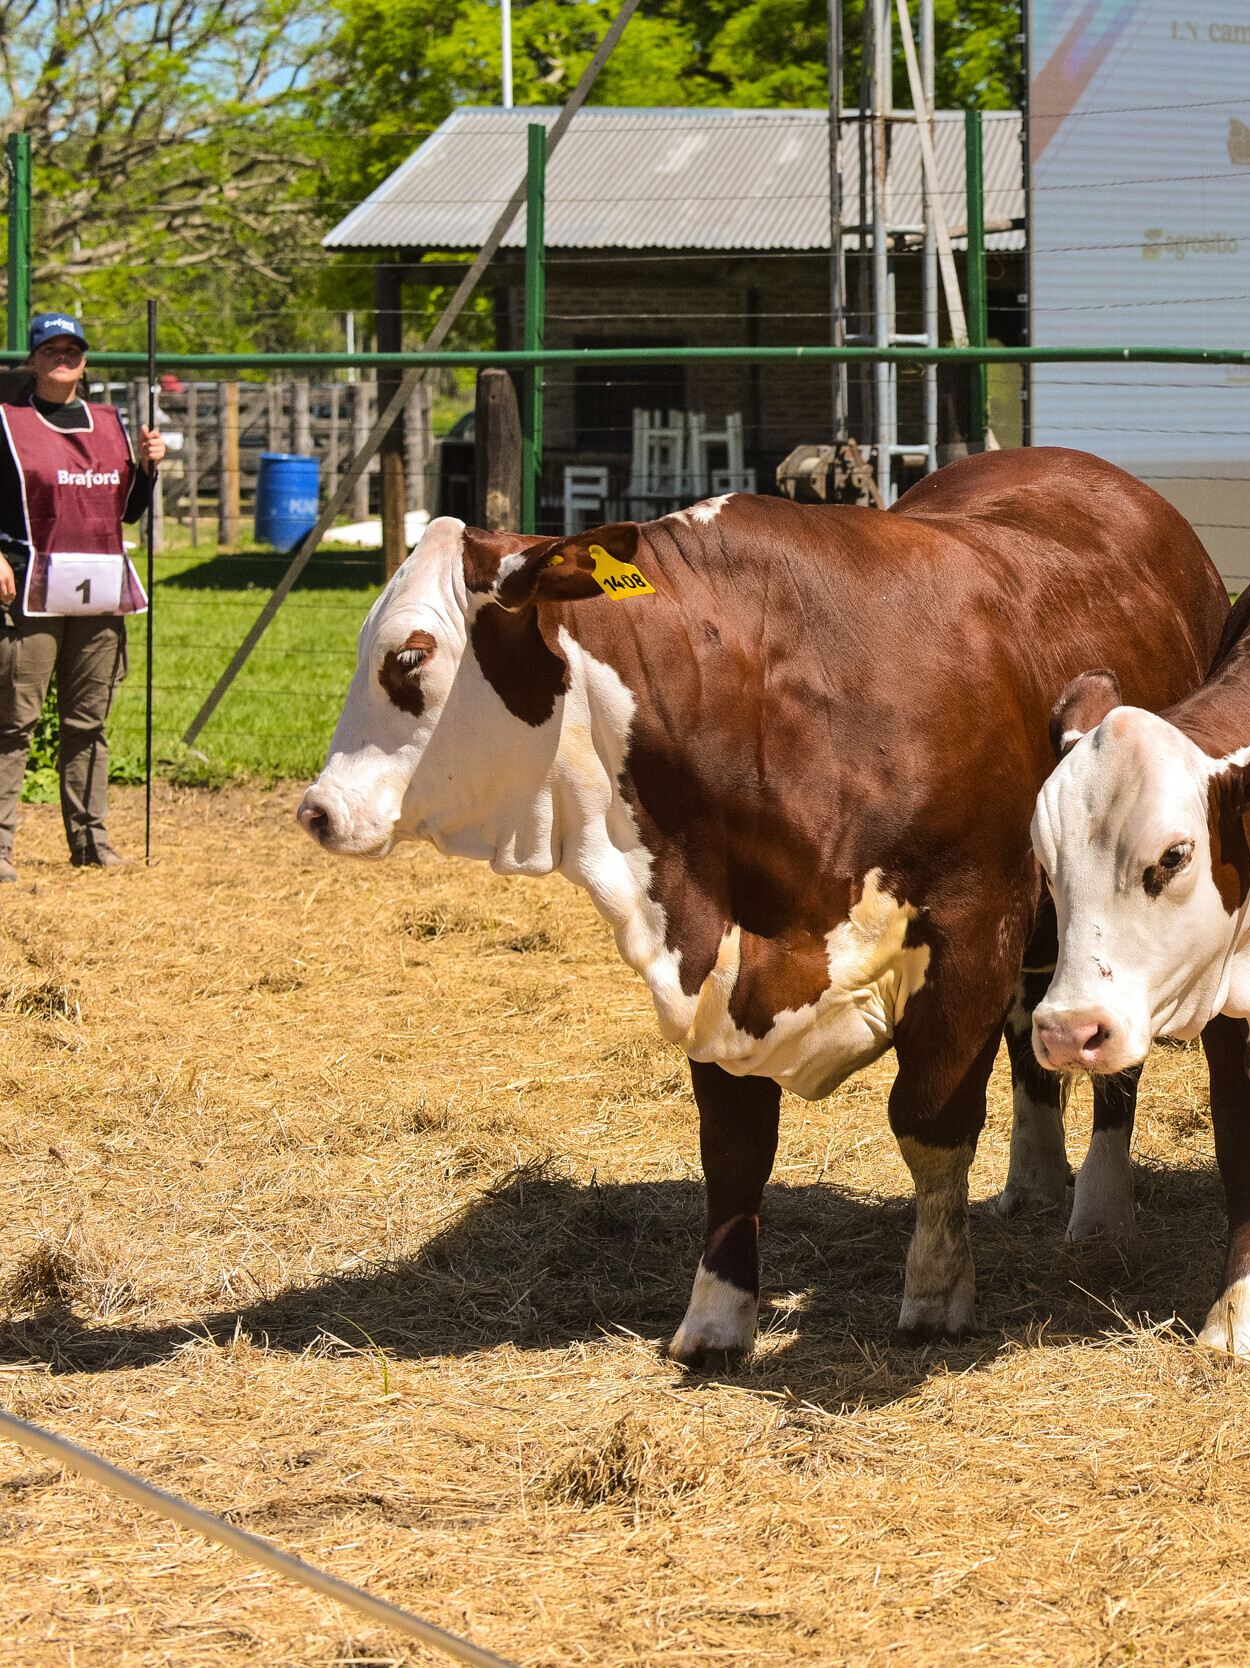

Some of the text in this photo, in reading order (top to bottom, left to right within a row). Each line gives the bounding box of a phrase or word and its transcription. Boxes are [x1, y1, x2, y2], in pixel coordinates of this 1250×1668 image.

[57, 469, 120, 488] Braford
[75, 578, 91, 604] 1
[603, 573, 647, 592] 1408
